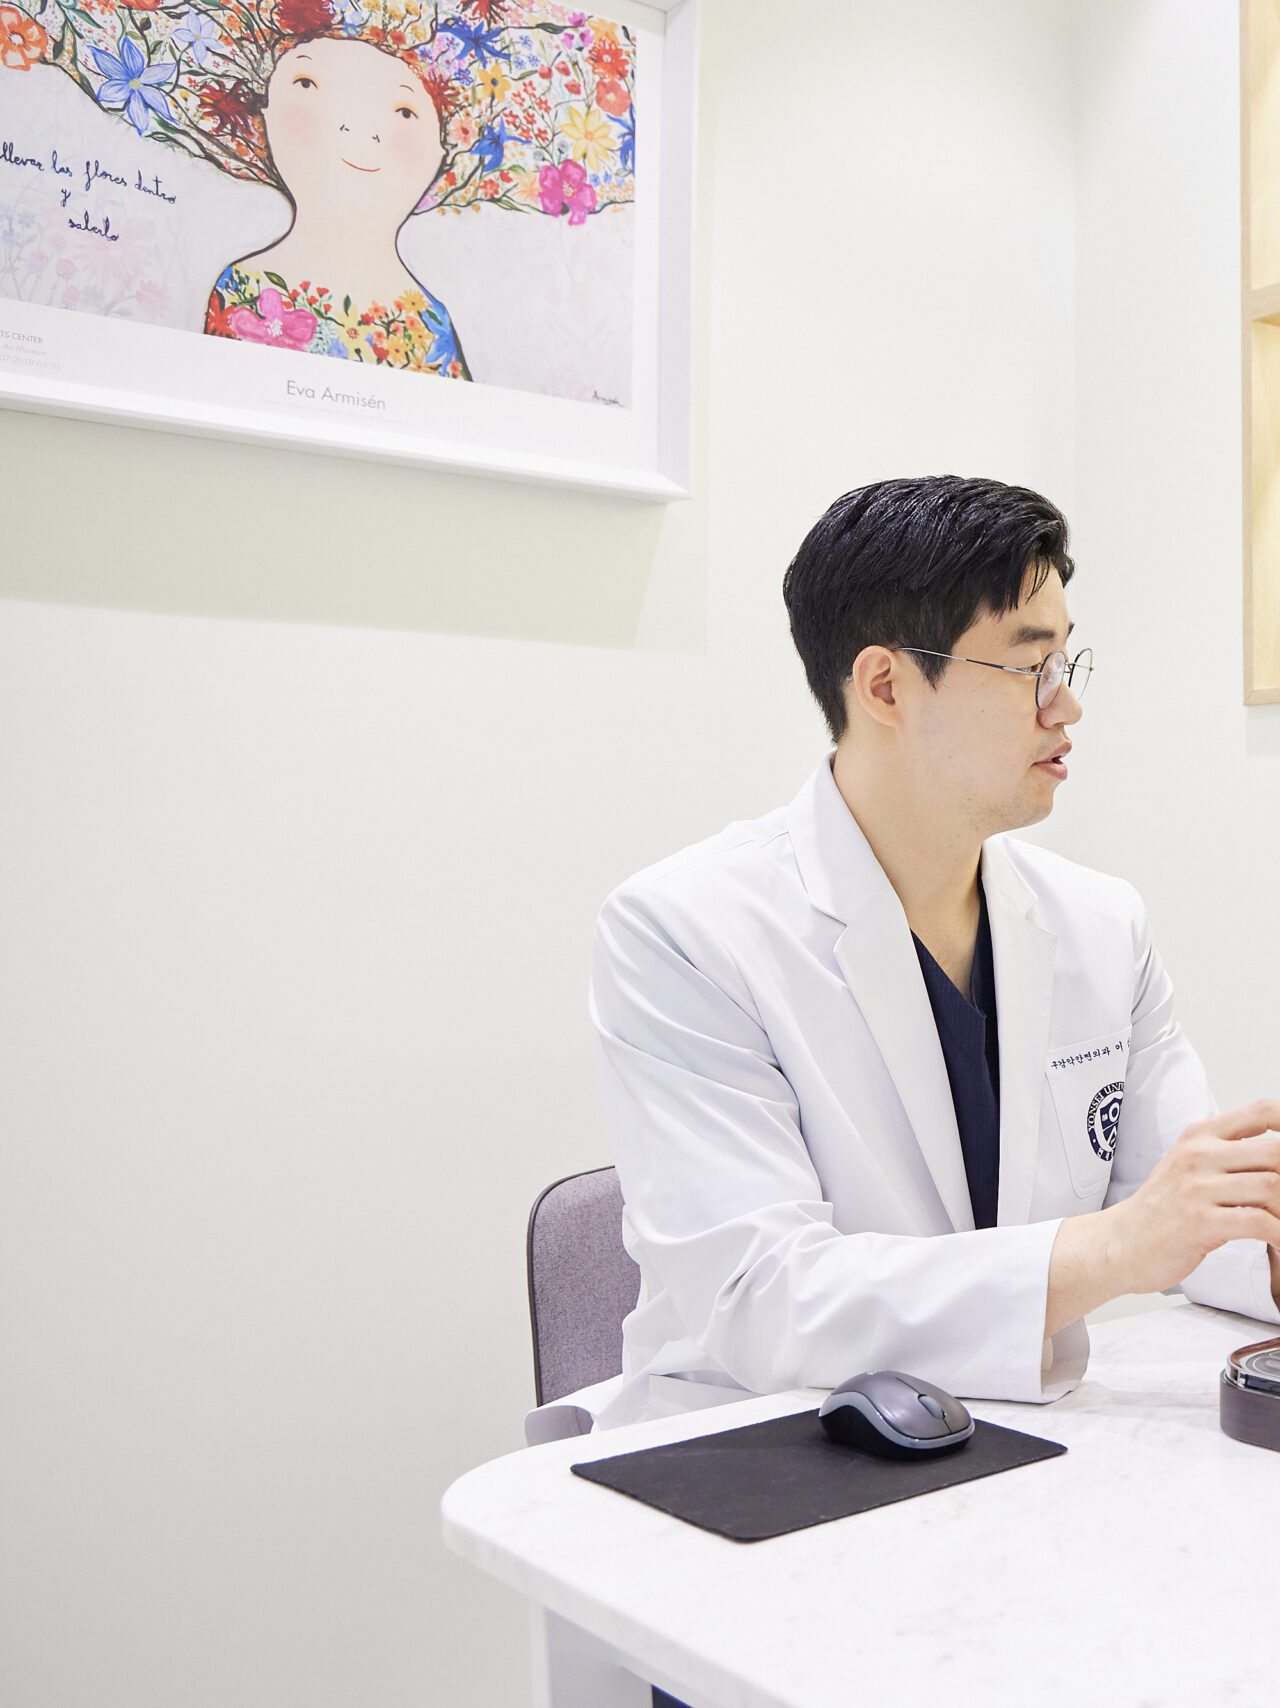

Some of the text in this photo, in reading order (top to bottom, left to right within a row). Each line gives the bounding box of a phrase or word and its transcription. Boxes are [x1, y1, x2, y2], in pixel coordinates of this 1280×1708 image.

[51, 150, 73, 178] las
[84, 159, 128, 191] flores
[134, 169, 177, 204] dentro
[60, 188, 72, 207] y
[11, 332, 43, 344] CENTER
[286, 379, 386, 411] Eva Armisén
[1051, 1046, 1111, 1070] 구강악안면외과
[1087, 1091, 1104, 1133] YONSEI
